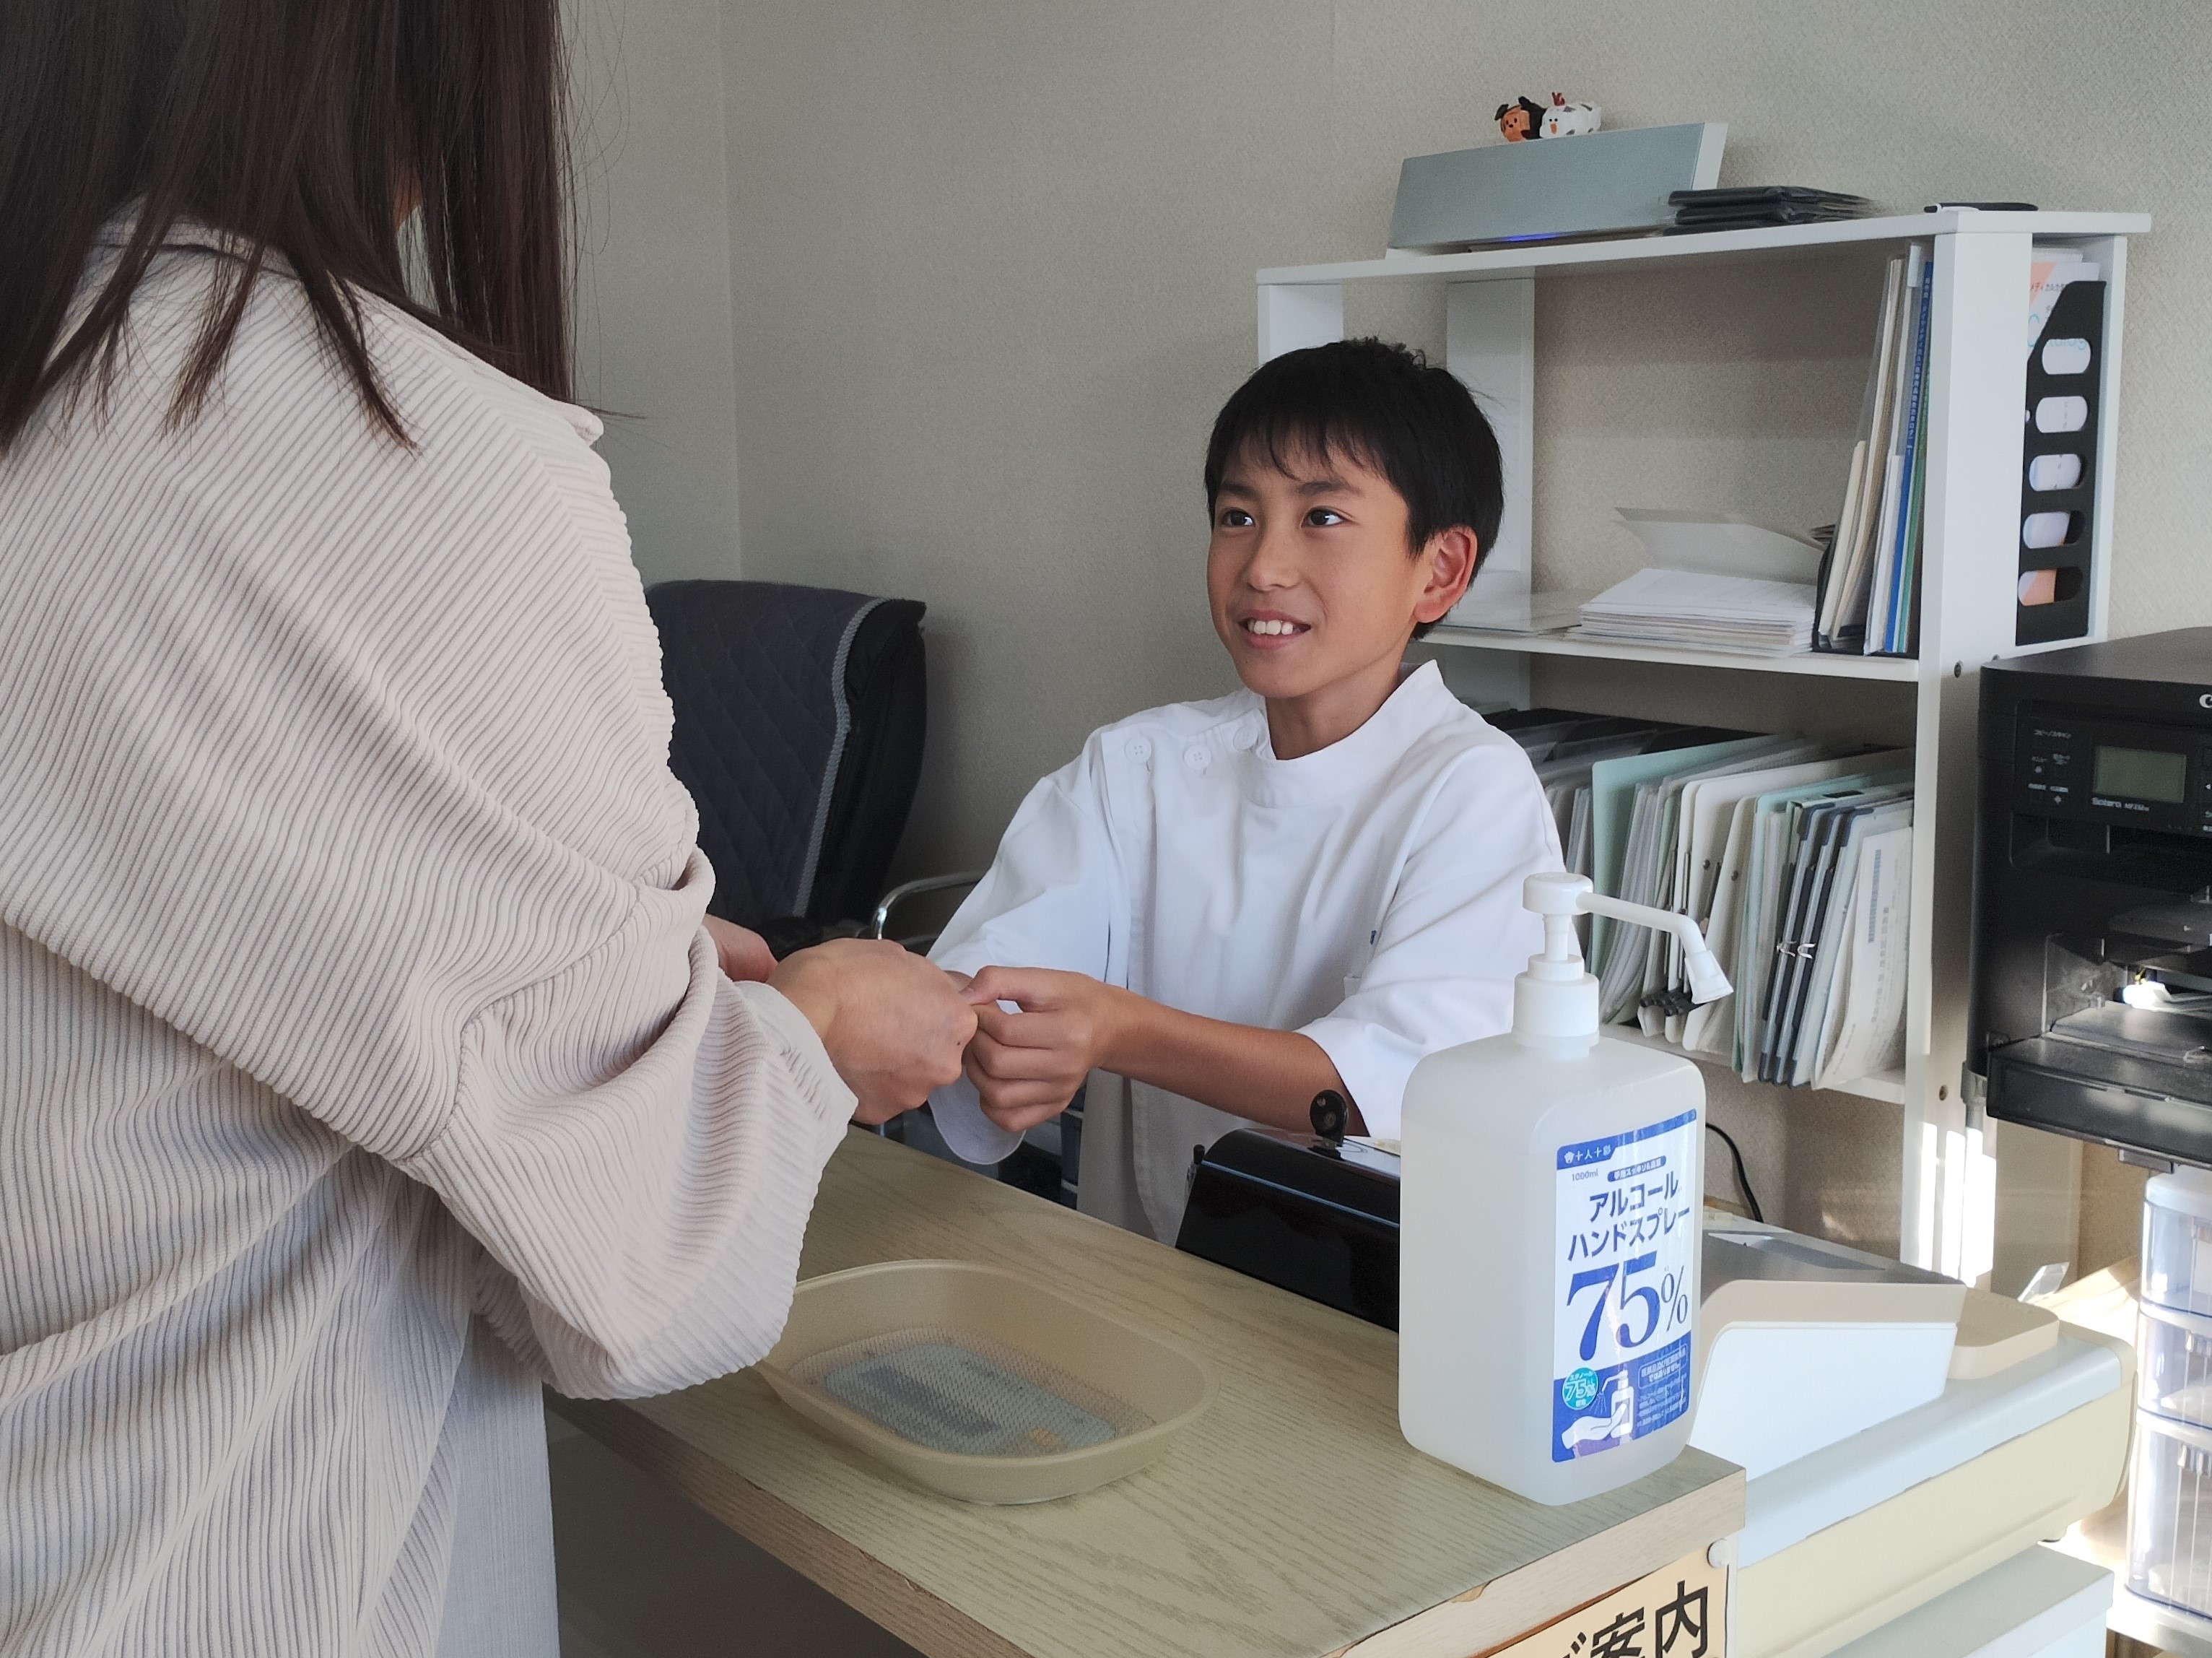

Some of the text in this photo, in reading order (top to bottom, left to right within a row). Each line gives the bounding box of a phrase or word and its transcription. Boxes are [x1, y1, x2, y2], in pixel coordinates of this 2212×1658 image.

[1590, 1171, 1679, 1223] アルコール
[1567, 1207, 1691, 1261] ハンドスプレー
[1562, 1580, 1709, 1658] 案内
